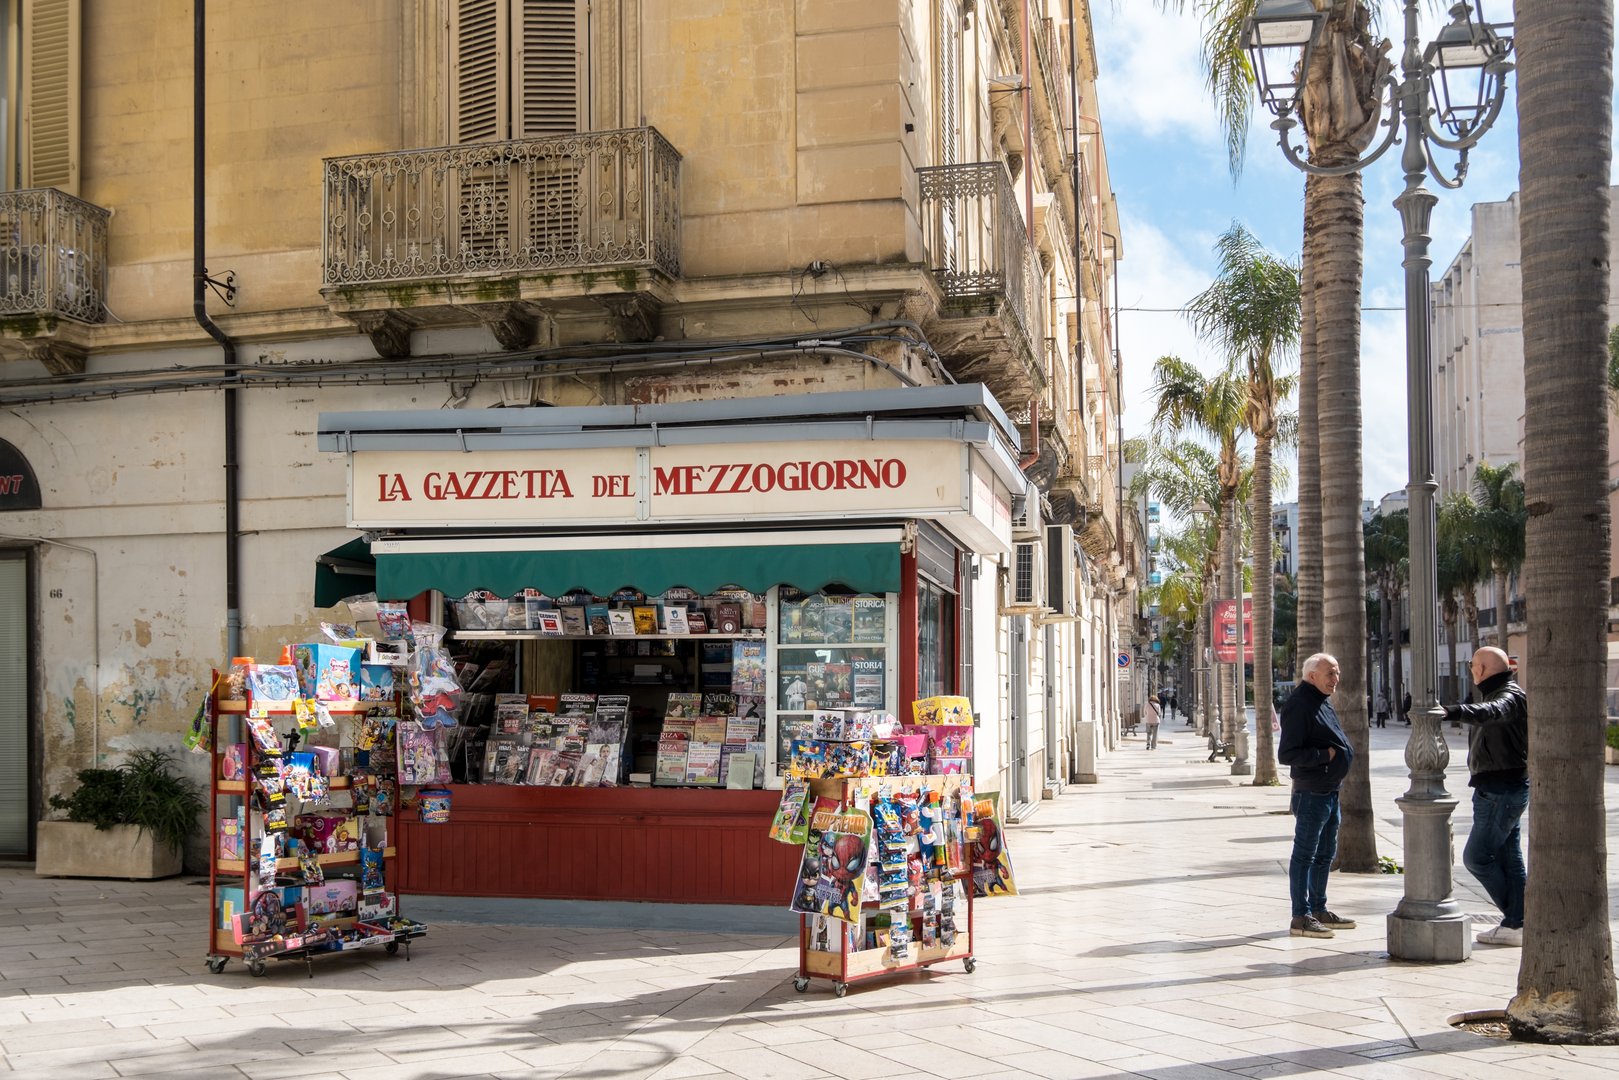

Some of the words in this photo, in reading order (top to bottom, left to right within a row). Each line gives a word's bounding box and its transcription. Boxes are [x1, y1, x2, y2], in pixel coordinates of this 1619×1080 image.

[378, 473, 412, 502] LA
[423, 469, 574, 501] GAZZETTA
[591, 475, 636, 498] DEL
[652, 458, 907, 496] MEZZOGIORNO
[50, 588, 63, 599] 66
[855, 600, 885, 608] STORICA
